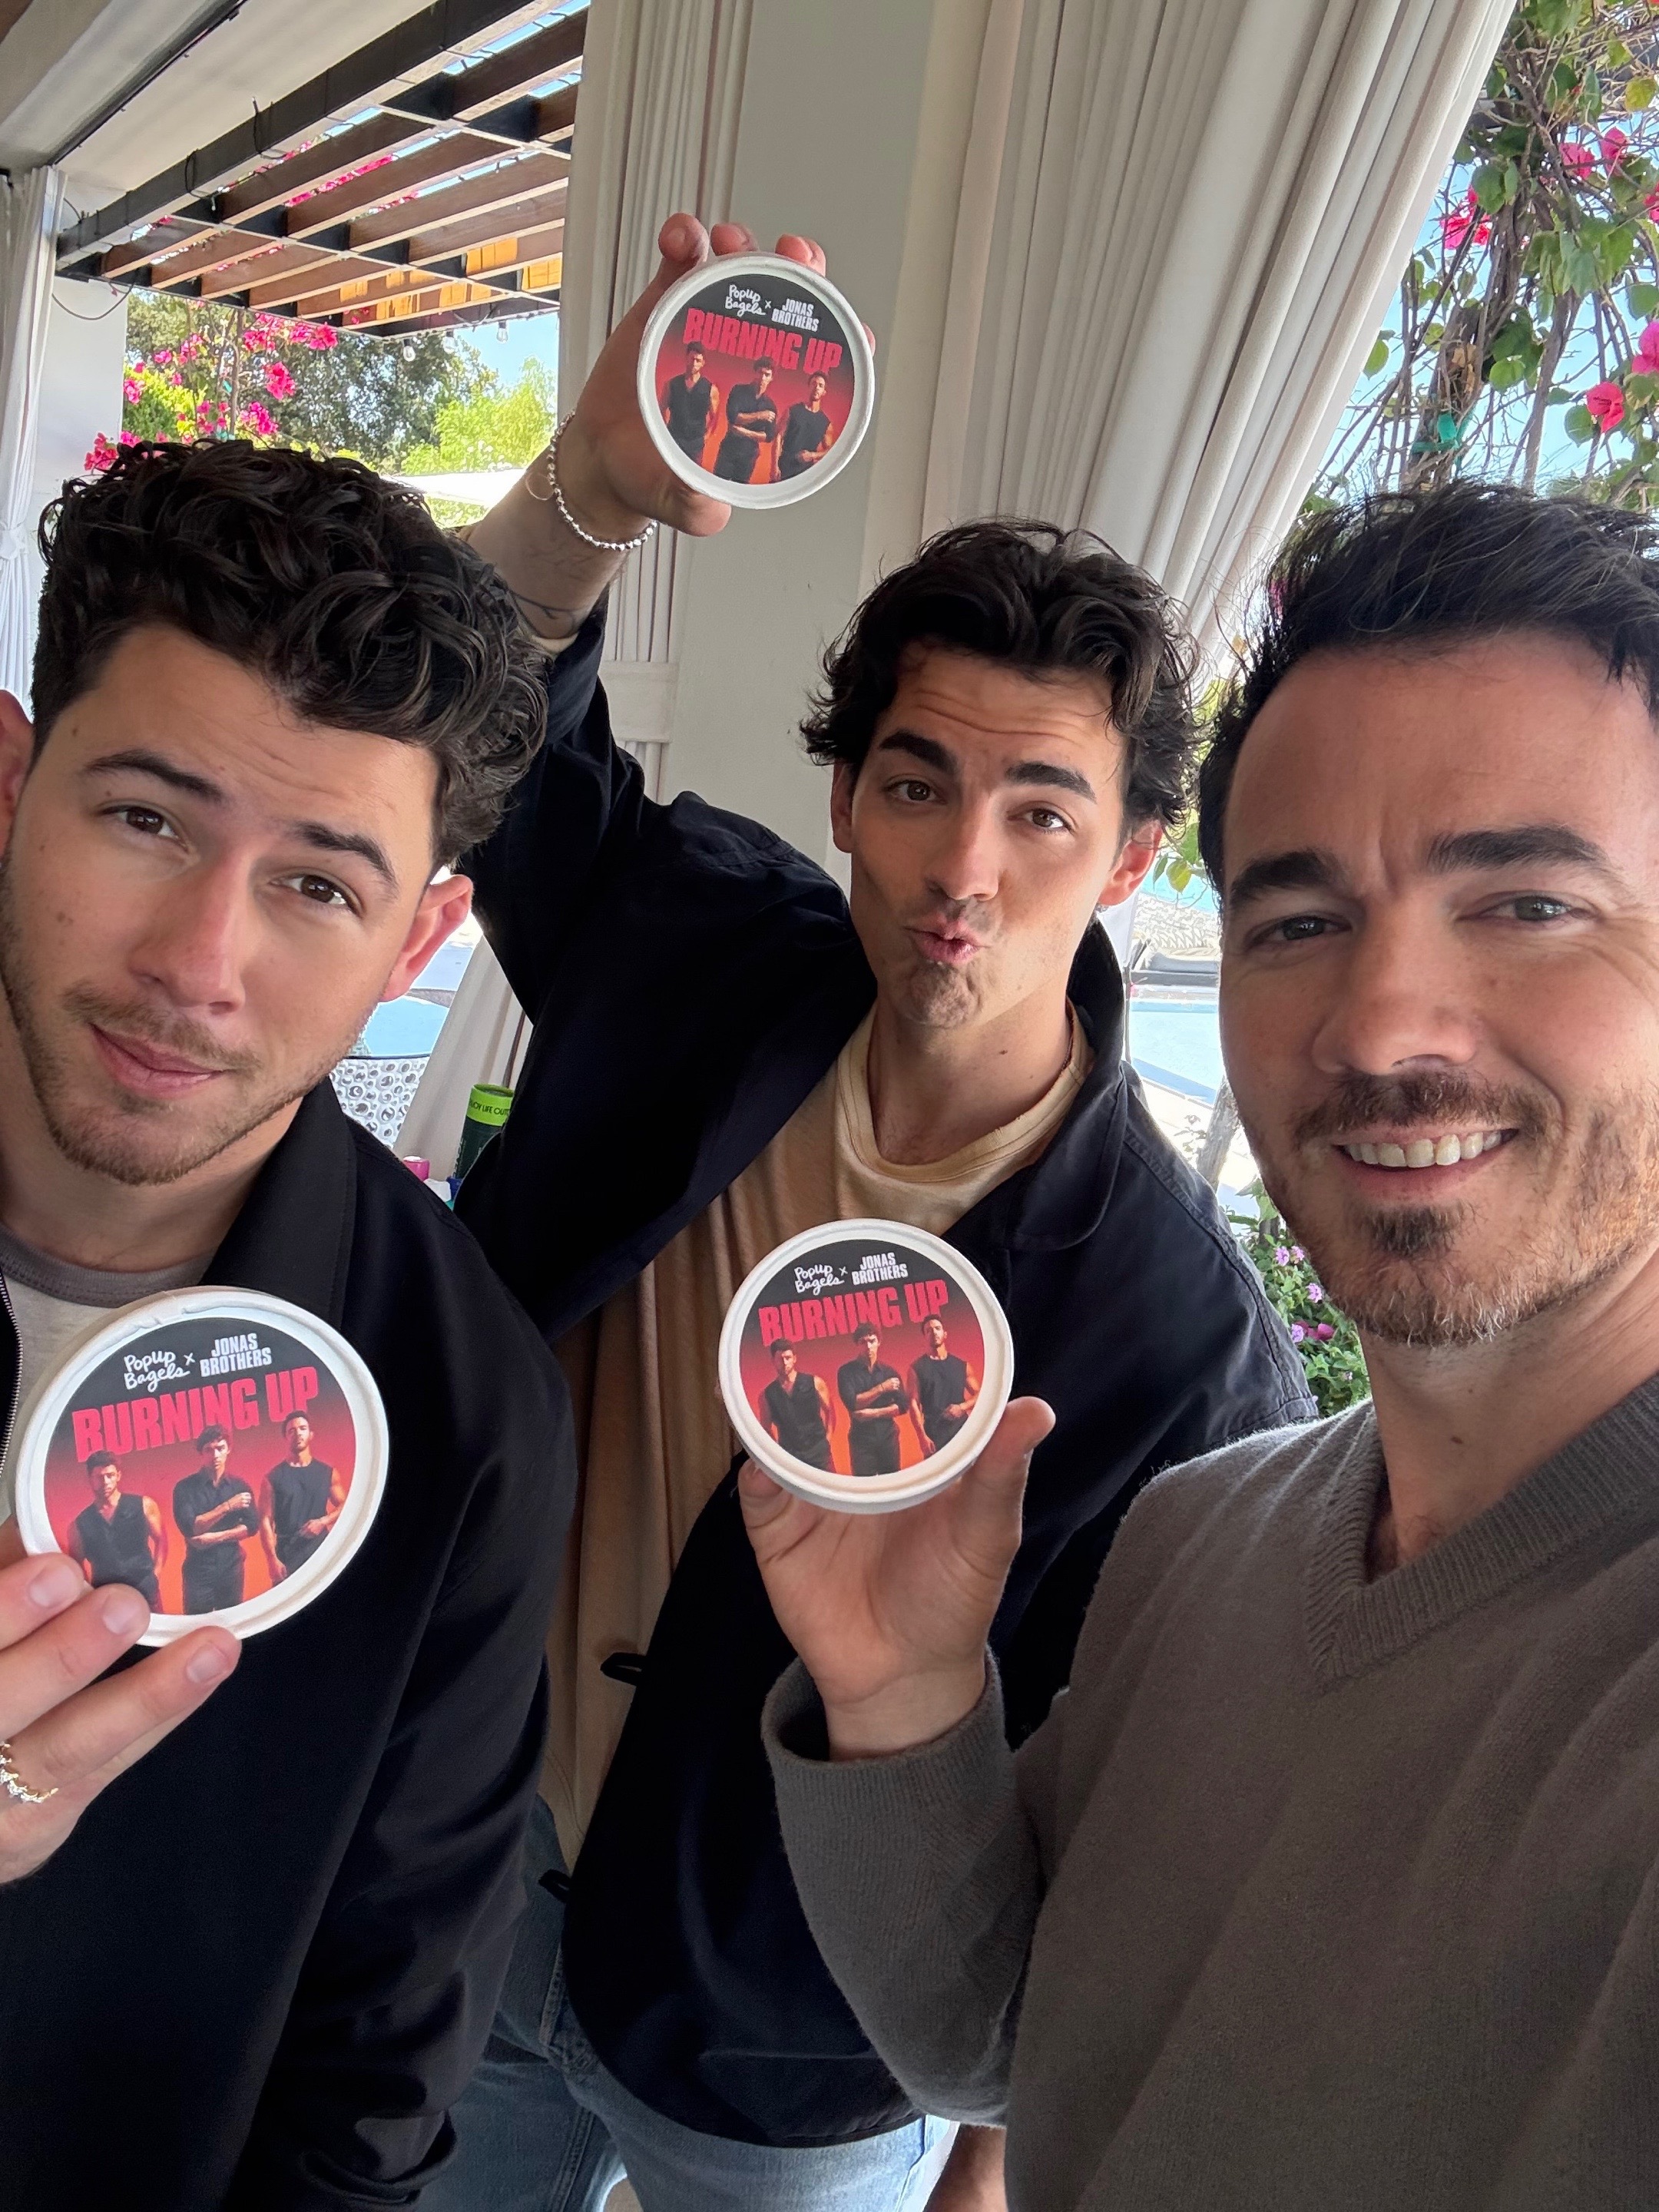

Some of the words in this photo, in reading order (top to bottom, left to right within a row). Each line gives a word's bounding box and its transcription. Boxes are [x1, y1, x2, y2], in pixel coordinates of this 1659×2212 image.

[725, 296, 767, 317] Bagels
[782, 298, 814, 317] JONAS
[771, 308, 820, 332] BROTHERS
[683, 307, 803, 370] BURNING
[803, 337, 843, 375] UP
[859, 1252, 896, 1270] JONAS
[794, 1273, 845, 1296] Bagels
[851, 1263, 909, 1286] BROTHERS
[758, 1286, 902, 1346] BURNING
[904, 1280, 949, 1323] UP
[211, 1333, 259, 1358] JONAS
[199, 1346, 273, 1377] BROTHERS
[124, 1363, 190, 1392] Bagels
[71, 1377, 260, 1462] BURNING
[264, 1366, 319, 1423] UP
